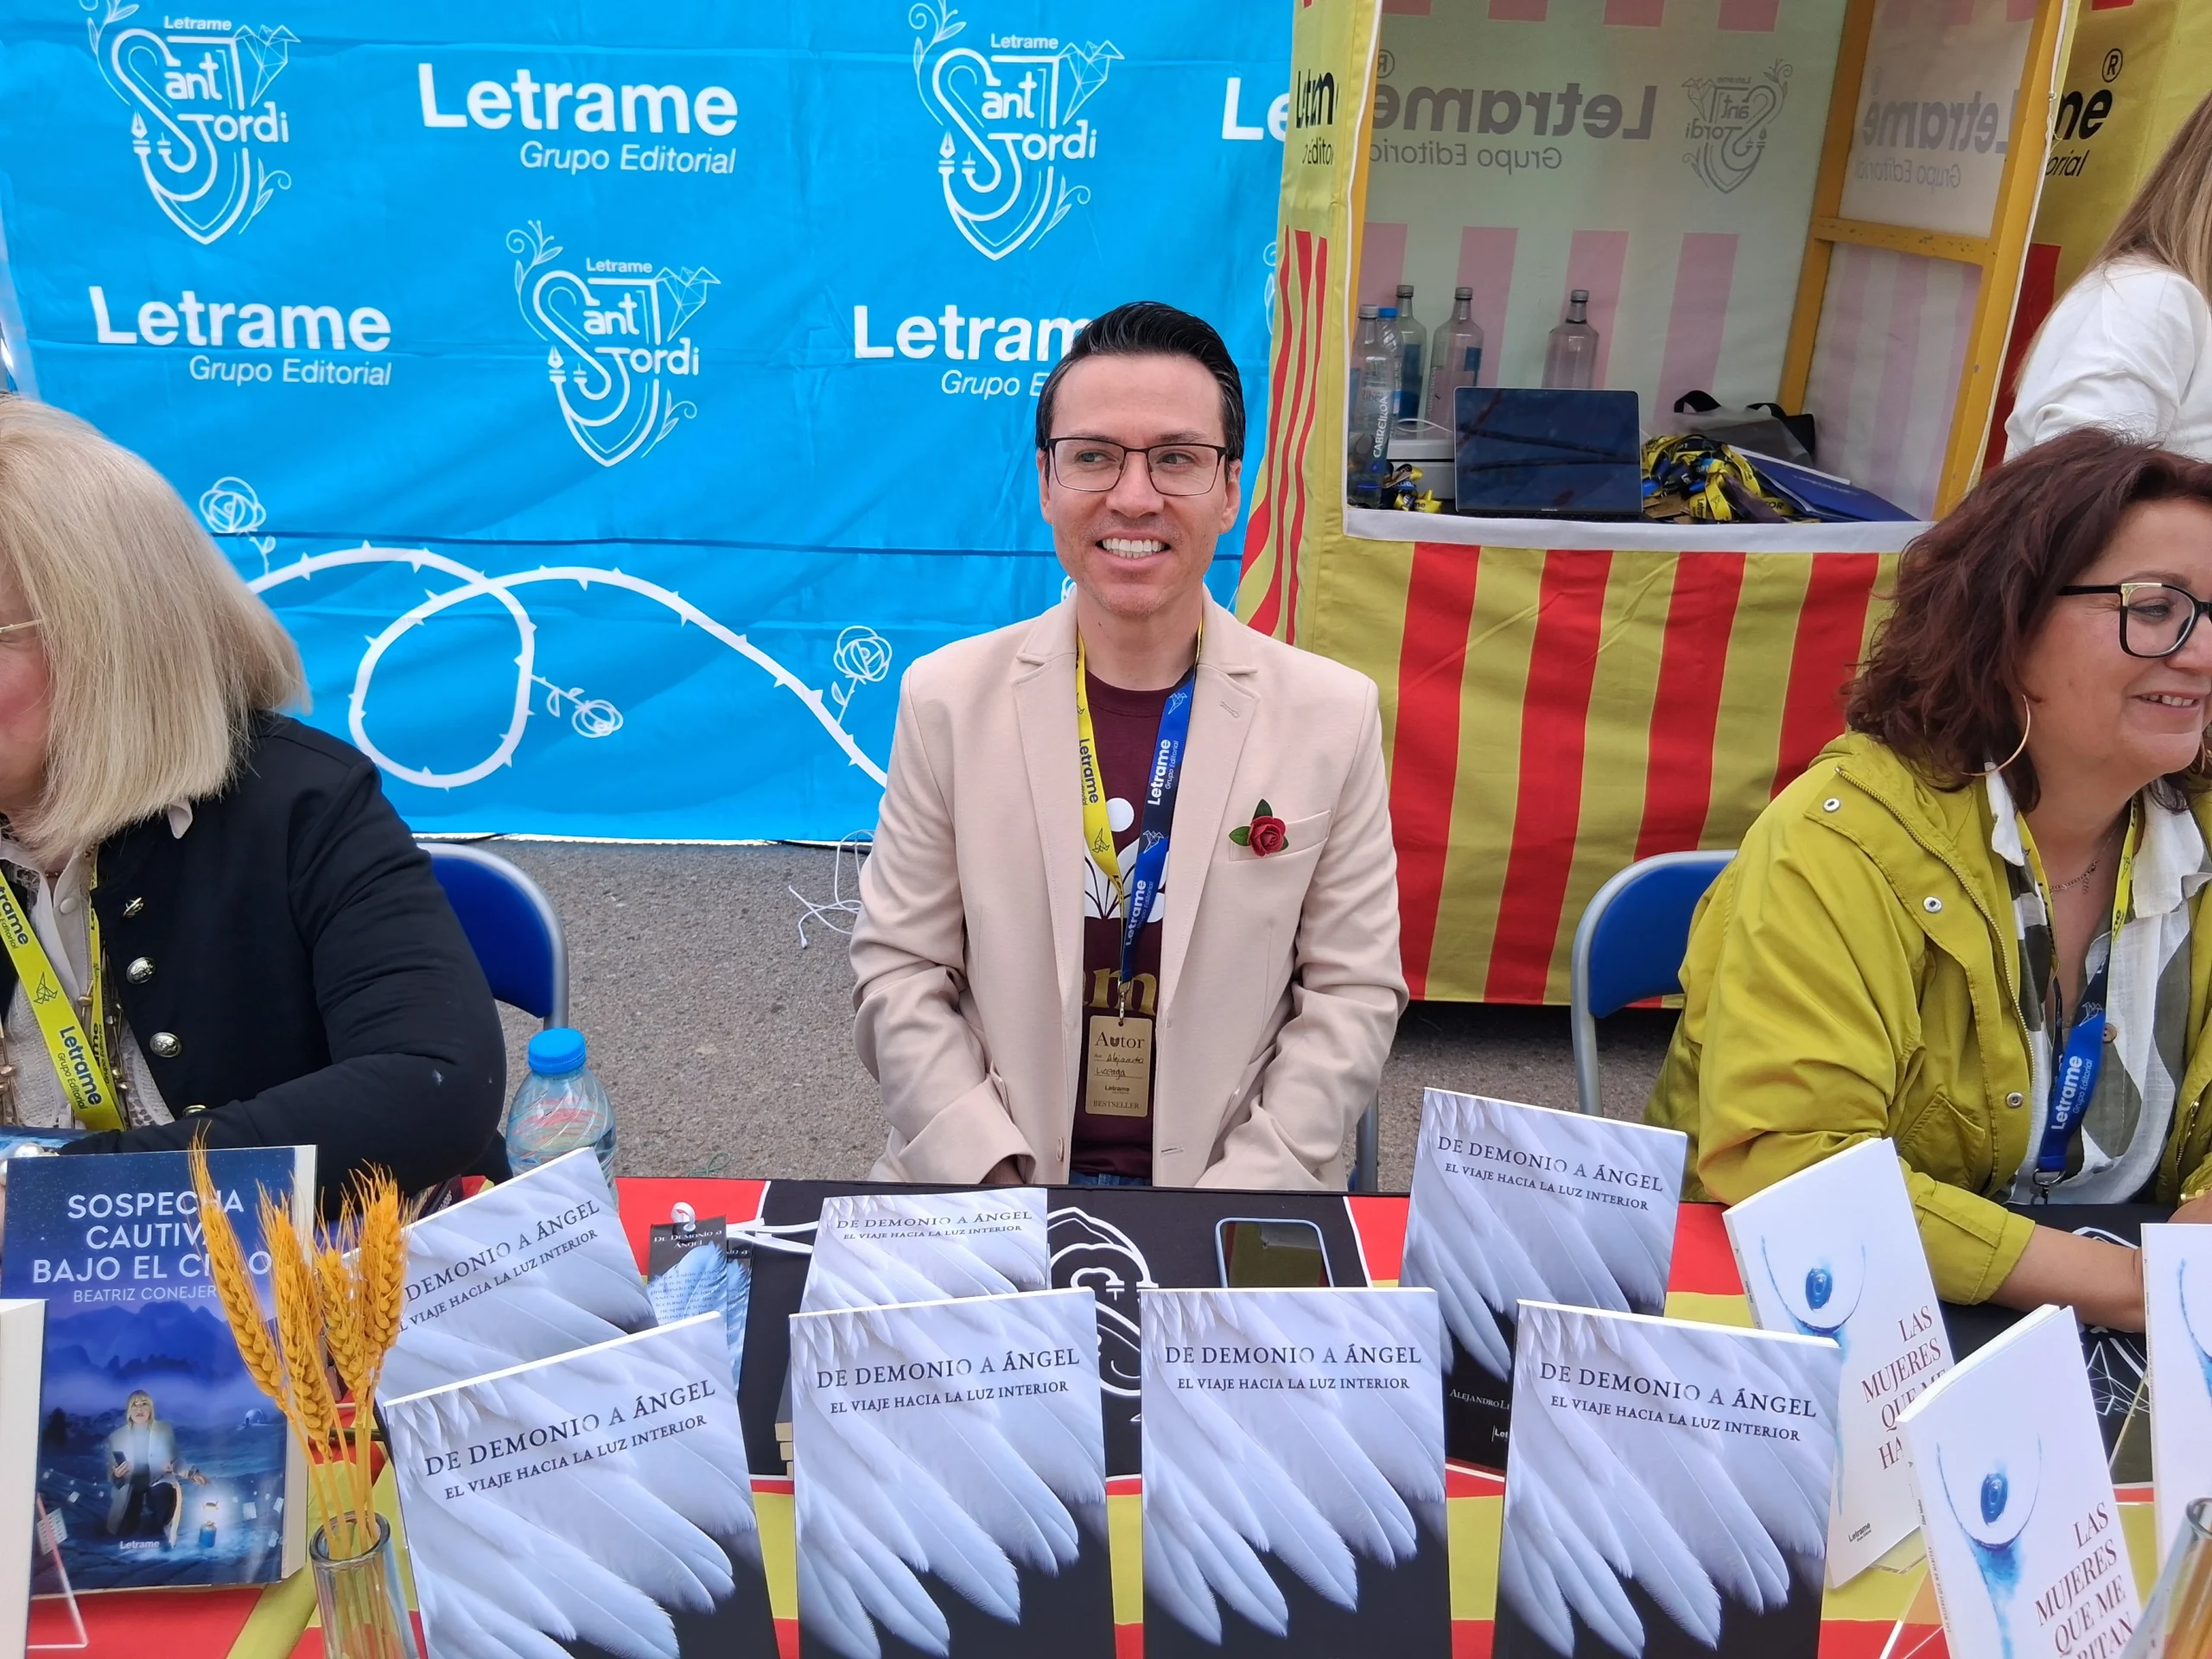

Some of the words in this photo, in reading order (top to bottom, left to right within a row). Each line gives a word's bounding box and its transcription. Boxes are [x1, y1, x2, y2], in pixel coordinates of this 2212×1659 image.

[164, 16, 232, 30] Letrame
[991, 34, 1058, 49] Letrame
[418, 62, 738, 136] Letrame
[520, 141, 610, 175] Grupo
[620, 143, 737, 175] Editorial
[587, 258, 653, 275] Letrame
[88, 286, 391, 352] Letrame
[189, 354, 272, 386] Grupo
[283, 358, 391, 386] Editorial
[941, 370, 1020, 400] Grupo
[1079, 738, 1099, 804] Letrame
[1169, 740, 1179, 768] Editorial
[1147, 739, 1171, 806] Letrame
[1165, 768, 1175, 791] Grupo
[1125, 879, 1147, 947] Letrame
[1143, 880, 1154, 910] Editorial
[1094, 1031, 1146, 1049] Autor
[58, 1052, 72, 1077] Grupo
[67, 1077, 88, 1109] Editorial
[60, 1026, 102, 1105] Letrame
[1093, 1100, 1141, 1109] BESTSELLER
[2051, 1055, 2082, 1130] Letrame
[2073, 1089, 2087, 1115] Grupo
[2080, 1058, 2093, 1090] Editorial
[1437, 1136, 1463, 1154] DE
[1468, 1142, 1567, 1173] DEMONIO
[1573, 1163, 1586, 1178] A
[1592, 1165, 1663, 1192] ÁNGEL
[1445, 1162, 1459, 1173] EL
[1463, 1166, 1494, 1181] VIAJE
[1497, 1173, 1536, 1190] HACIA
[1540, 1181, 1555, 1192] LA
[1559, 1185, 1582, 1198] LUZ
[1586, 1190, 1649, 1211] INTERIOR
[86, 1223, 208, 1249] CAUTIV
[836, 1219, 859, 1229] DE
[864, 1216, 951, 1228] DEMONIO
[974, 1210, 1033, 1224] ÁNGEL
[968, 1225, 1022, 1235] INTERIOR
[33, 1257, 120, 1283] BAJO
[134, 1255, 168, 1280] EL
[179, 1251, 272, 1278] CIO
[404, 1242, 512, 1302] DEMONIO
[518, 1235, 532, 1250] A
[536, 1200, 601, 1242] ÁNGEL
[73, 1287, 136, 1303] BEATRIZ
[409, 1301, 448, 1325] VIAJE
[448, 1282, 493, 1307] HACIA
[493, 1274, 512, 1290] LA
[512, 1259, 539, 1278] LUZ
[540, 1229, 598, 1264] INTERIOR
[1897, 1305, 1933, 1343] LAS
[817, 1370, 849, 1389] DE
[855, 1359, 971, 1385] DEMONIO
[979, 1358, 995, 1372] A
[1001, 1348, 1080, 1371] ÁNGEL
[1166, 1346, 1194, 1363] DE
[1201, 1346, 1314, 1363] DEMONIO
[1322, 1347, 1338, 1363] A
[1344, 1343, 1421, 1363] ÁNGEL
[1861, 1337, 1942, 1404] MUJERES
[830, 1402, 847, 1414] EL
[850, 1398, 890, 1413] VIAJE
[894, 1395, 942, 1408] HACIA
[945, 1393, 963, 1403] LA
[967, 1388, 995, 1401] LUZ
[998, 1380, 1069, 1399] INTERIOR
[1178, 1378, 1193, 1389] EL
[1198, 1378, 1235, 1390] VIAJE
[1238, 1378, 1284, 1389] HACIA
[1287, 1378, 1306, 1389] LA
[1309, 1378, 1336, 1389] LUZ
[1339, 1378, 1410, 1389] INTERIOR
[1540, 1362, 1572, 1383] DE
[1580, 1368, 1700, 1402] DEMONIO
[1709, 1388, 1725, 1405] A
[1731, 1388, 1817, 1418] ÁNGEL
[424, 1450, 461, 1477] DE
[468, 1414, 600, 1465] DEMONIO
[608, 1407, 625, 1426] A
[632, 1379, 715, 1419] ÁNGEL
[1551, 1395, 1567, 1408] EL
[1573, 1399, 1611, 1415] VIAJE
[1615, 1405, 1664, 1422] HACIA
[1669, 1414, 1688, 1426] LA
[1692, 1417, 1720, 1431] LUZ
[1724, 1421, 1802, 1442] INTERIOR
[445, 1485, 465, 1500] EL
[467, 1471, 513, 1493] VIAJE
[517, 1458, 569, 1480] HACIA
[572, 1450, 594, 1464] LA
[597, 1440, 628, 1458] LUZ
[631, 1414, 708, 1447] INTERIOR
[1847, 1522, 1872, 1543] Letrame
[2072, 1501, 2108, 1549] LAS
[119, 1538, 160, 1550] Letrame
[1928, 1547, 1936, 1571] HABITAN
[2034, 1538, 2117, 1627] MUJERES
[1939, 1596, 1948, 1621] MUJERES
[2055, 1601, 2094, 1658] QUE
[2094, 1574, 2126, 1618] ME
